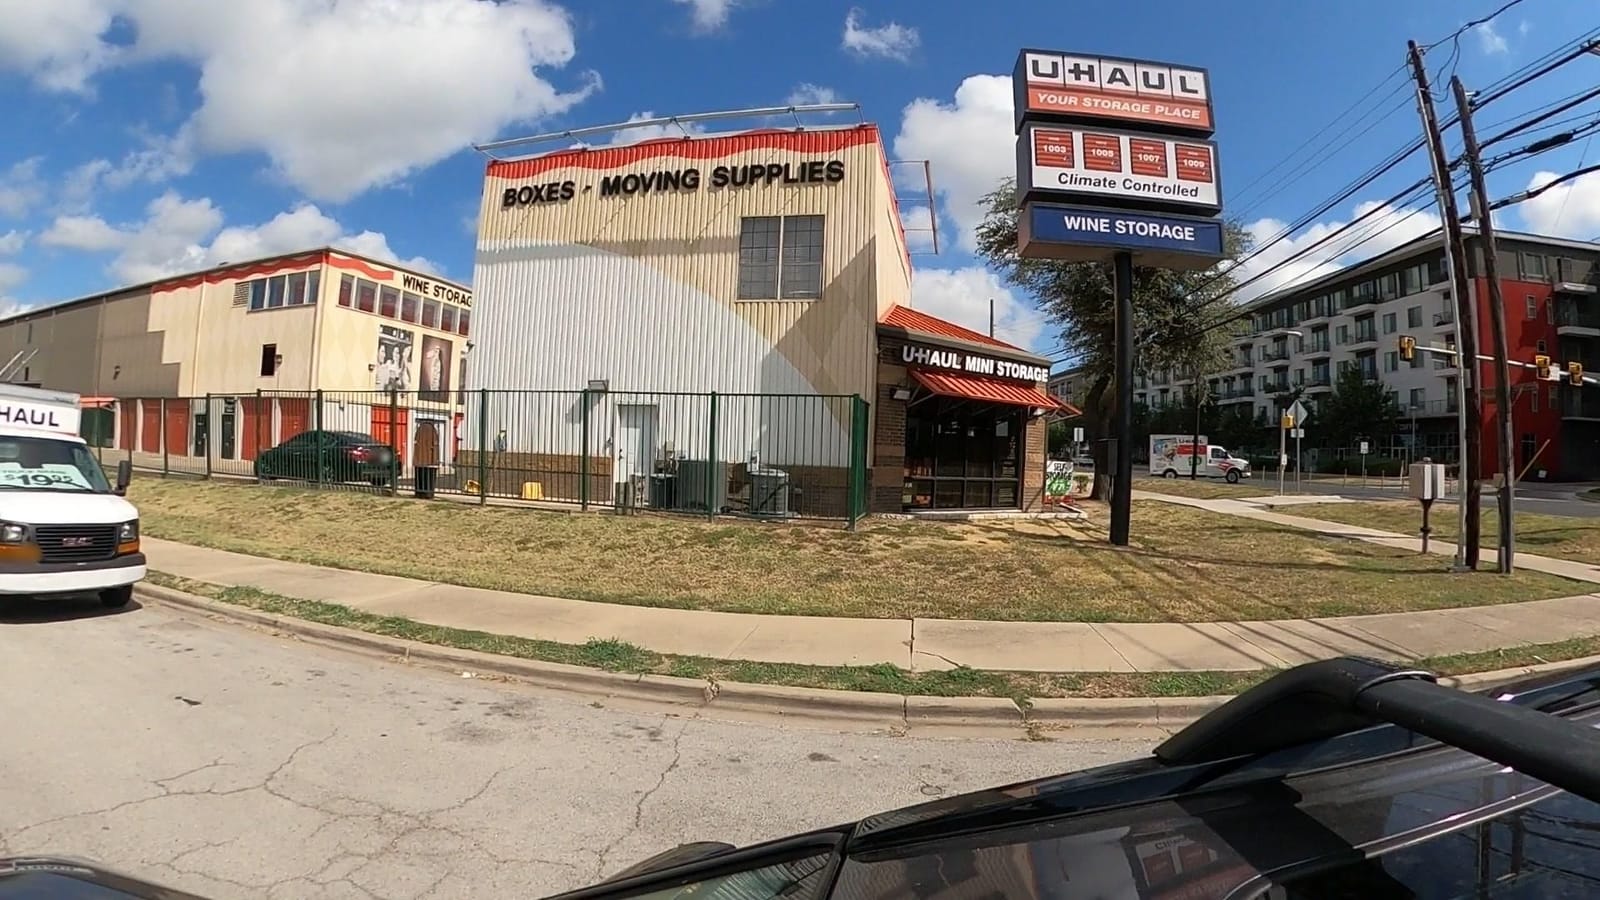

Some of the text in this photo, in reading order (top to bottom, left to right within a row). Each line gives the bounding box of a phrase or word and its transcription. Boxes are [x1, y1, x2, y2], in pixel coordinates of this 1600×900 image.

[1037, 93, 1201, 119] YOUR STORAGE PLACE
[1043, 144, 1067, 153] 1003
[1137, 153, 1161, 163] 1007
[503, 180, 575, 207] BOXES
[601, 168, 700, 196] MOVING
[711, 160, 845, 187] SUPPLIES
[1058, 172, 1199, 198] Climate Controlled
[1064, 215, 1195, 241] WINE STORAGE
[403, 273, 472, 307] WINE STORAG
[965, 355, 994, 375] MINI
[997, 361, 1049, 383] STORAGE
[0, 406, 59, 427] HAUL
